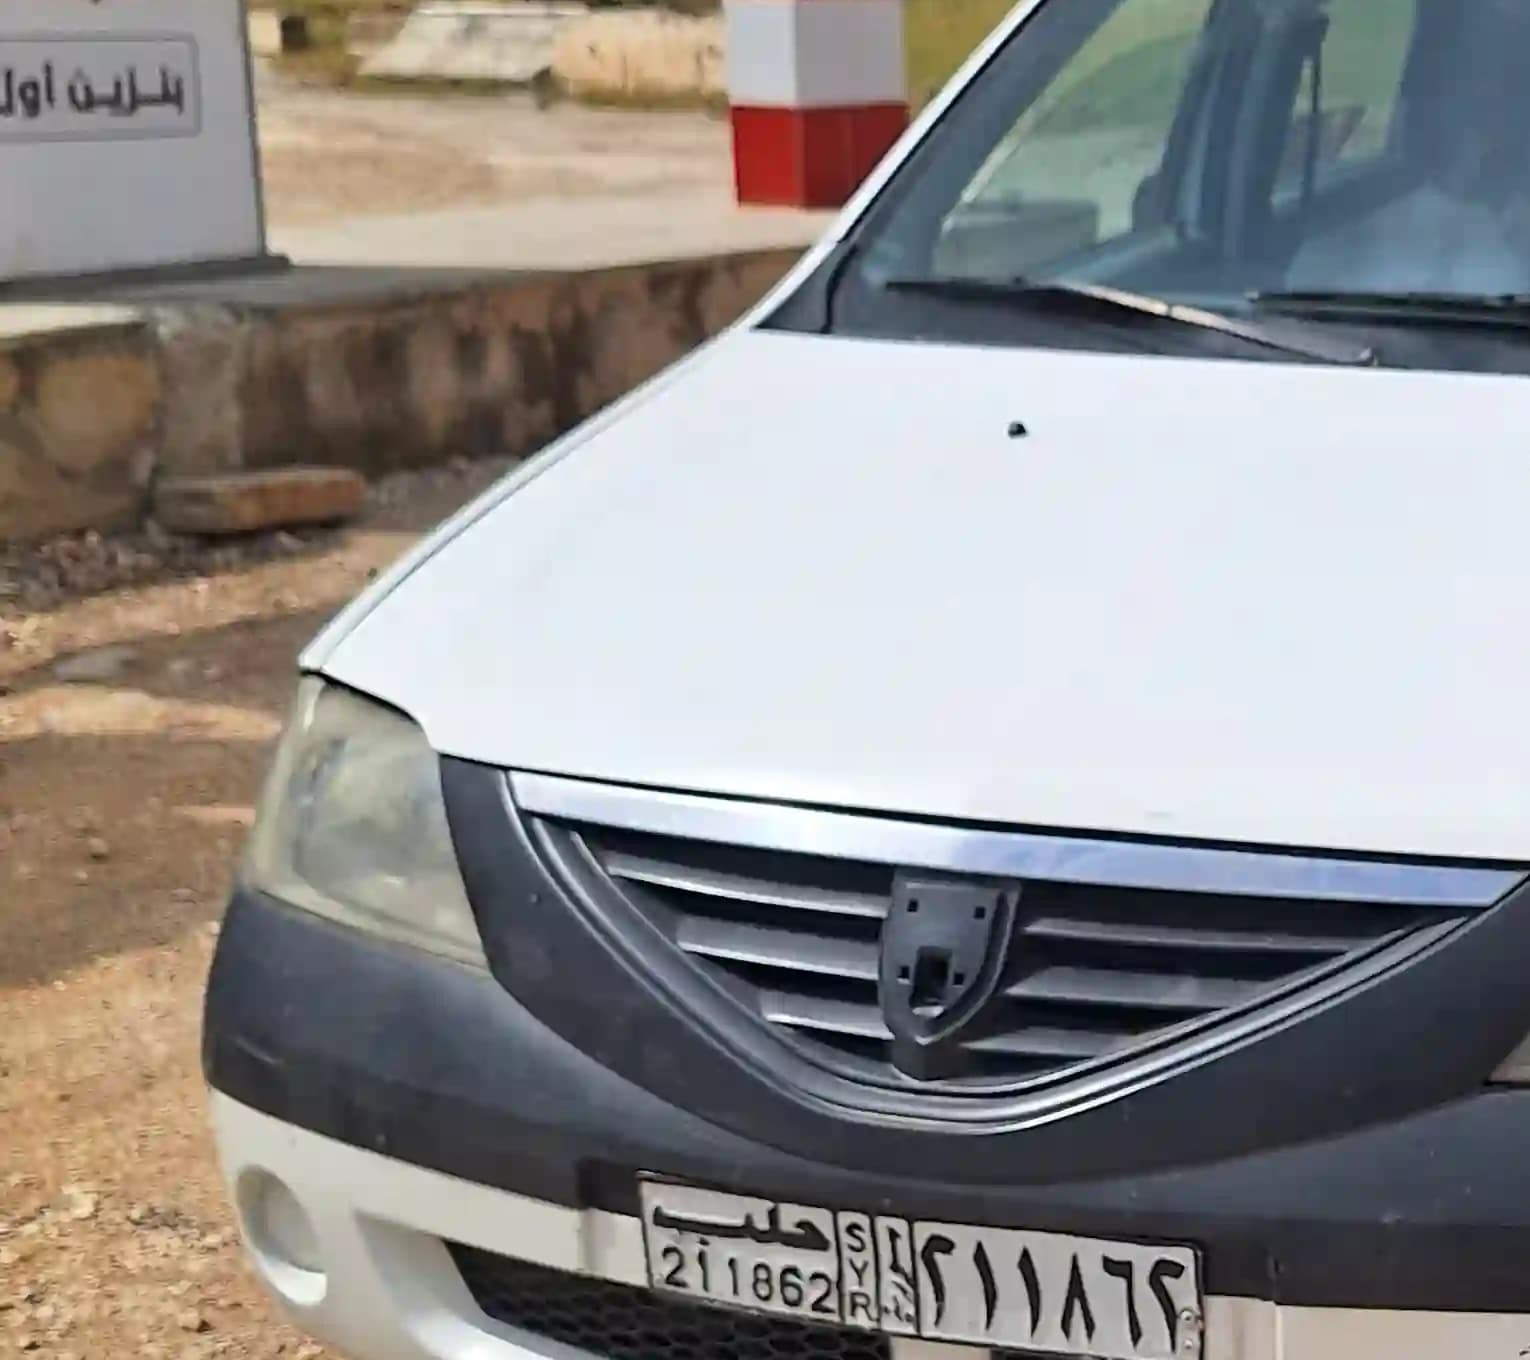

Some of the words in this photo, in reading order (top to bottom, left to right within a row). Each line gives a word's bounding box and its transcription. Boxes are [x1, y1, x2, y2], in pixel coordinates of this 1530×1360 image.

[66, 66, 184, 117] بنزين
[653, 1203, 830, 1251] حلب
[662, 1246, 835, 1313] 211862
[845, 1222, 878, 1321] SYR
